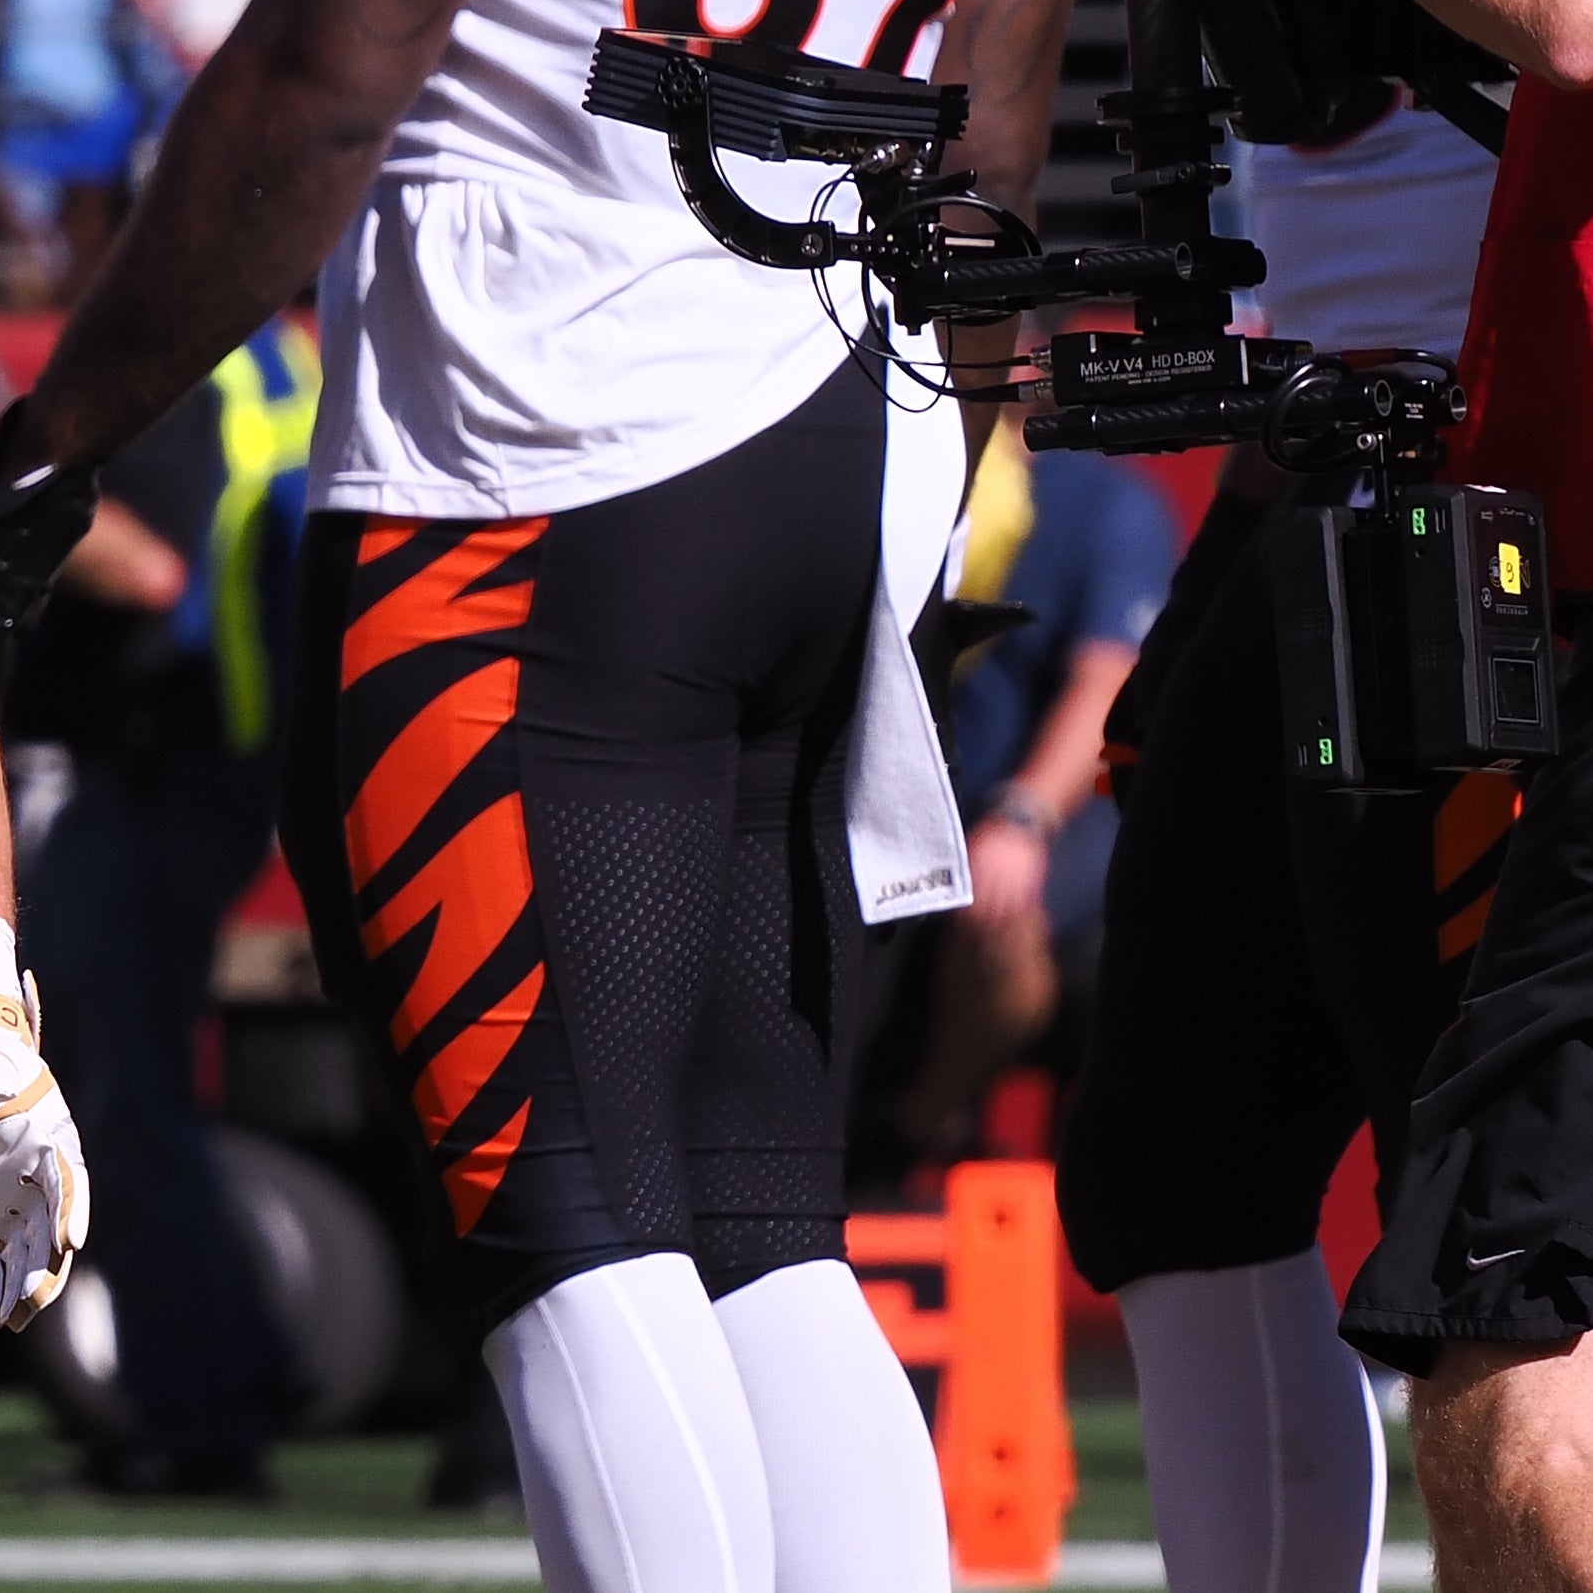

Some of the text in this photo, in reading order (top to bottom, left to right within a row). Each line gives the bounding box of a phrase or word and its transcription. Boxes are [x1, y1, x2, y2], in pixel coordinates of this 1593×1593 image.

[1080, 349, 1216, 377] MK-V V4 HD D-BOX
[1084, 375, 1111, 383] PATENT
[1112, 372, 1141, 381] PENDING
[1171, 364, 1213, 375] REGISTERED
